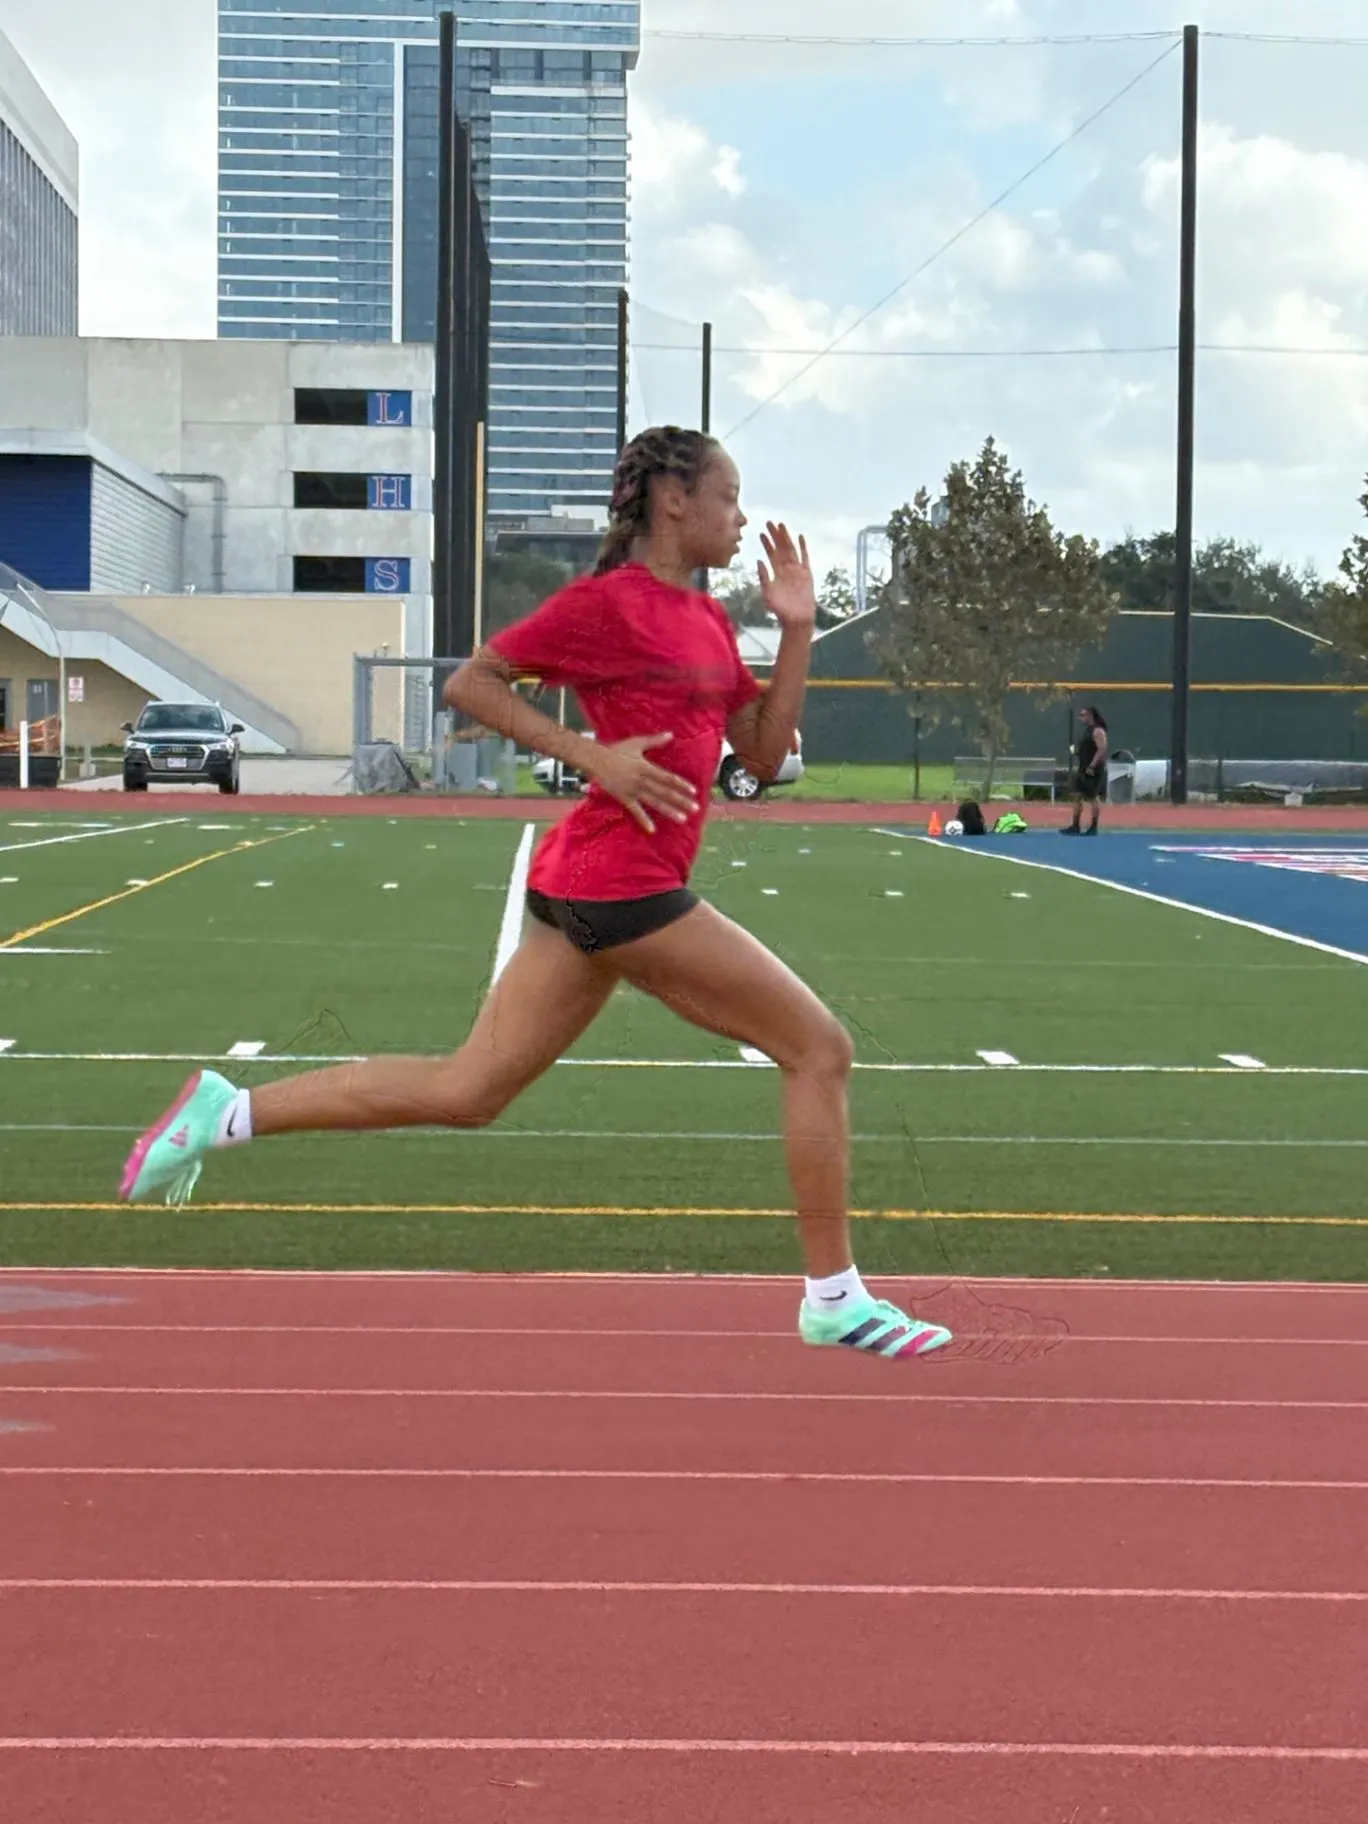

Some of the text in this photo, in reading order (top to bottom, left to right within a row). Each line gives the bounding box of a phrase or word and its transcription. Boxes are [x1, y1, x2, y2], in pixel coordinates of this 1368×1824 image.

[375, 392, 404, 424] L
[371, 476, 405, 508] H
[374, 559, 400, 591] S
